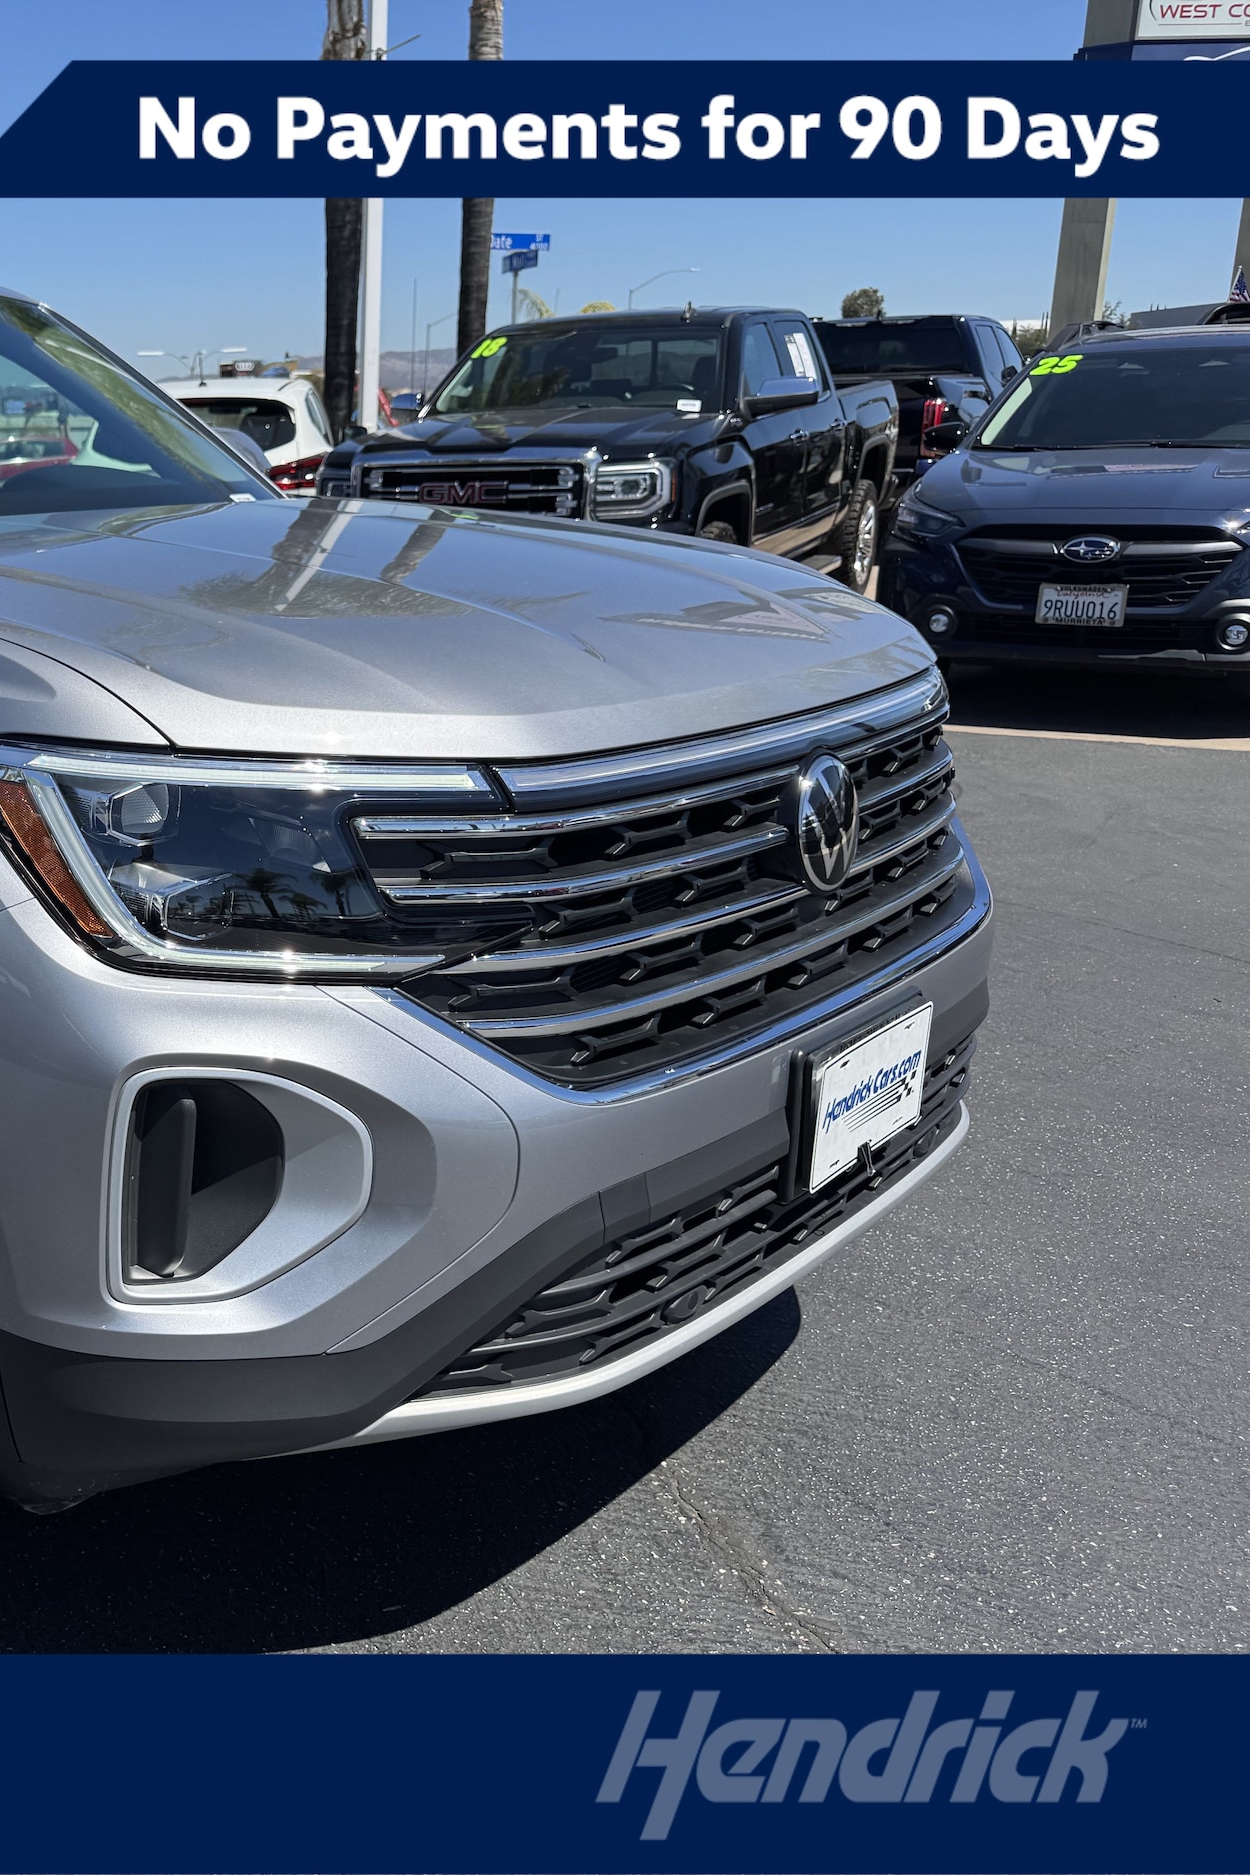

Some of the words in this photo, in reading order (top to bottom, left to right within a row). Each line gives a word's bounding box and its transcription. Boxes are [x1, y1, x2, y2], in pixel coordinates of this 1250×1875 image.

[1160, 4, 1222, 19] WEST
[470, 336, 508, 359] 18
[1029, 354, 1084, 376] 25
[419, 480, 508, 504] GMC
[1043, 599, 1119, 620] 9RUU016
